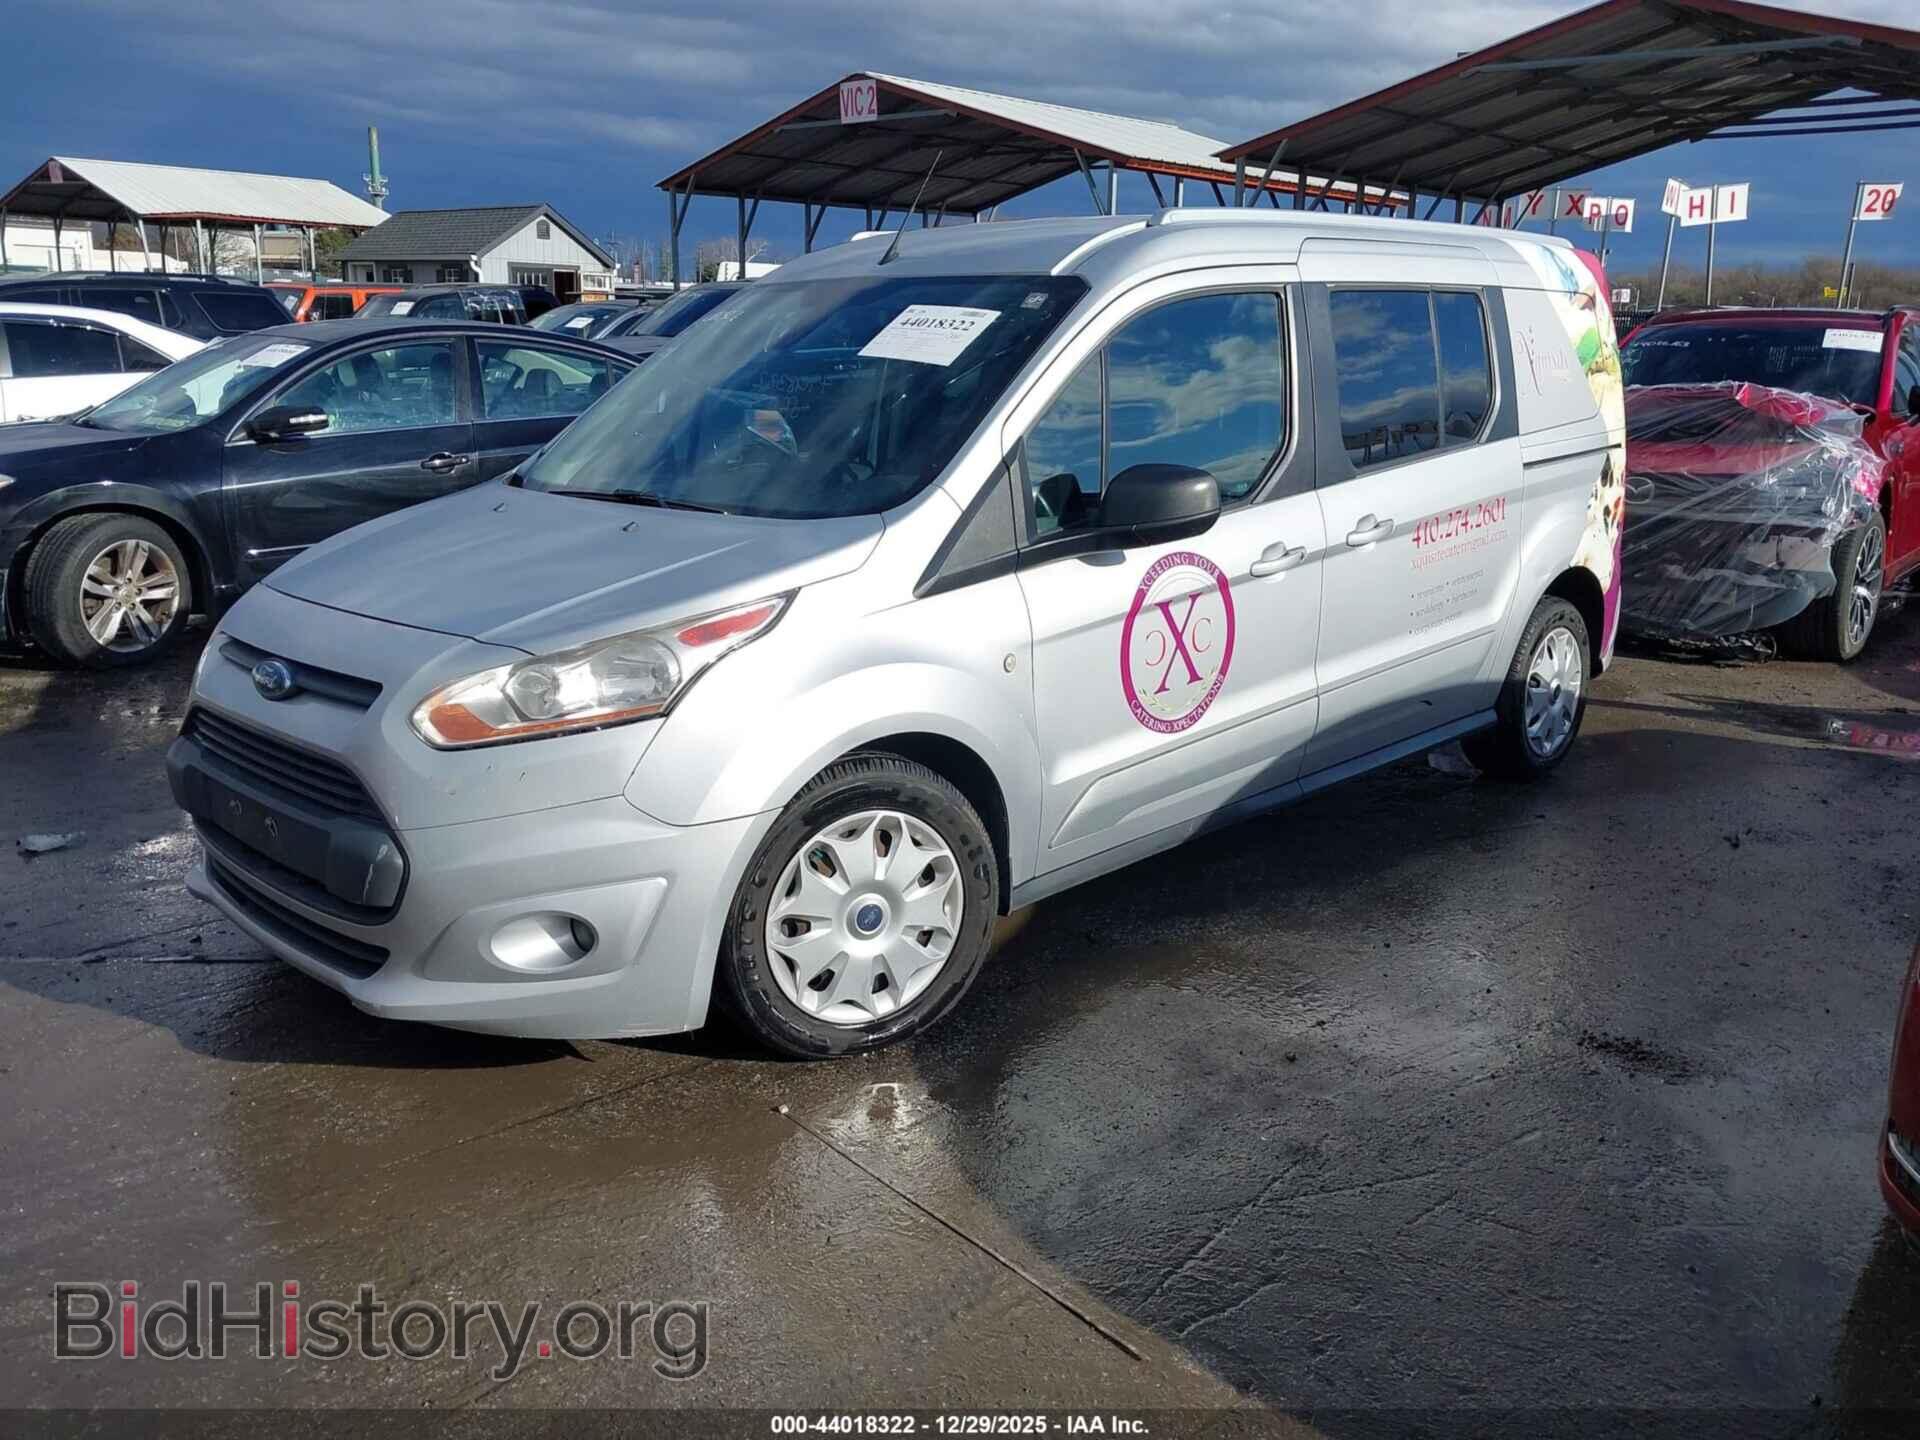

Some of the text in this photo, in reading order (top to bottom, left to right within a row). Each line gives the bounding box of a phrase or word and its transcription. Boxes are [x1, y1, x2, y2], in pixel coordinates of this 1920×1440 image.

[841, 85, 876, 117] VIC 2
[1527, 194, 1544, 215] Y
[1565, 194, 1586, 216] X
[1688, 194, 1705, 219] H
[1730, 191, 1736, 215] I
[1864, 188, 1897, 213] 20
[900, 317, 975, 332] 44018322
[1412, 497, 1506, 549] 410.274.2601
[1193, 554, 1220, 578] YOUR
[1131, 699, 1172, 733] CATERING
